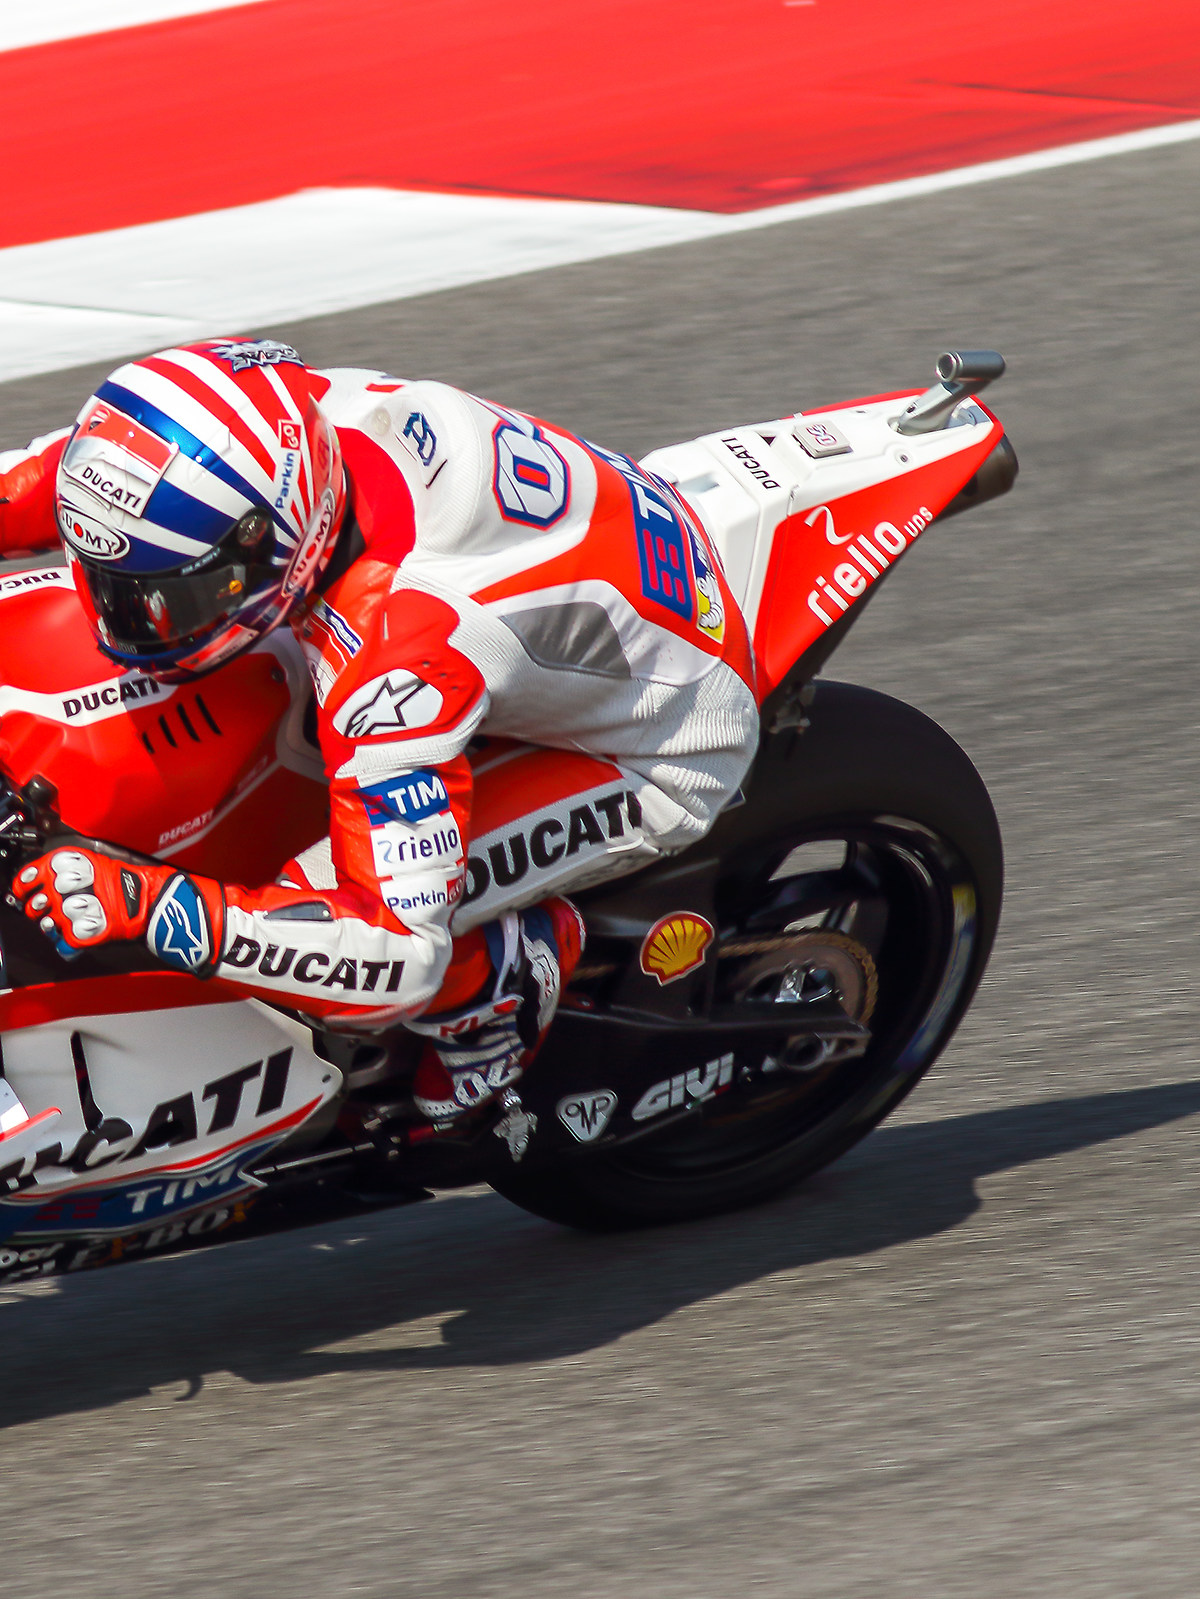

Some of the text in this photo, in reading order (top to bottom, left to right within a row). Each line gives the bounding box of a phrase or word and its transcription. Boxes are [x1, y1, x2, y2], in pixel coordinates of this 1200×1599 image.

[82, 466, 142, 508] DUCATI
[722, 437, 781, 490] DUCATI
[807, 506, 934, 627] riello ups
[62, 677, 161, 719] DUCATI
[387, 776, 447, 815] TIM
[398, 828, 458, 862] riello
[223, 936, 406, 993] DUCATI
[632, 1052, 736, 1122] GIVI
[125, 1163, 236, 1214] TIM
